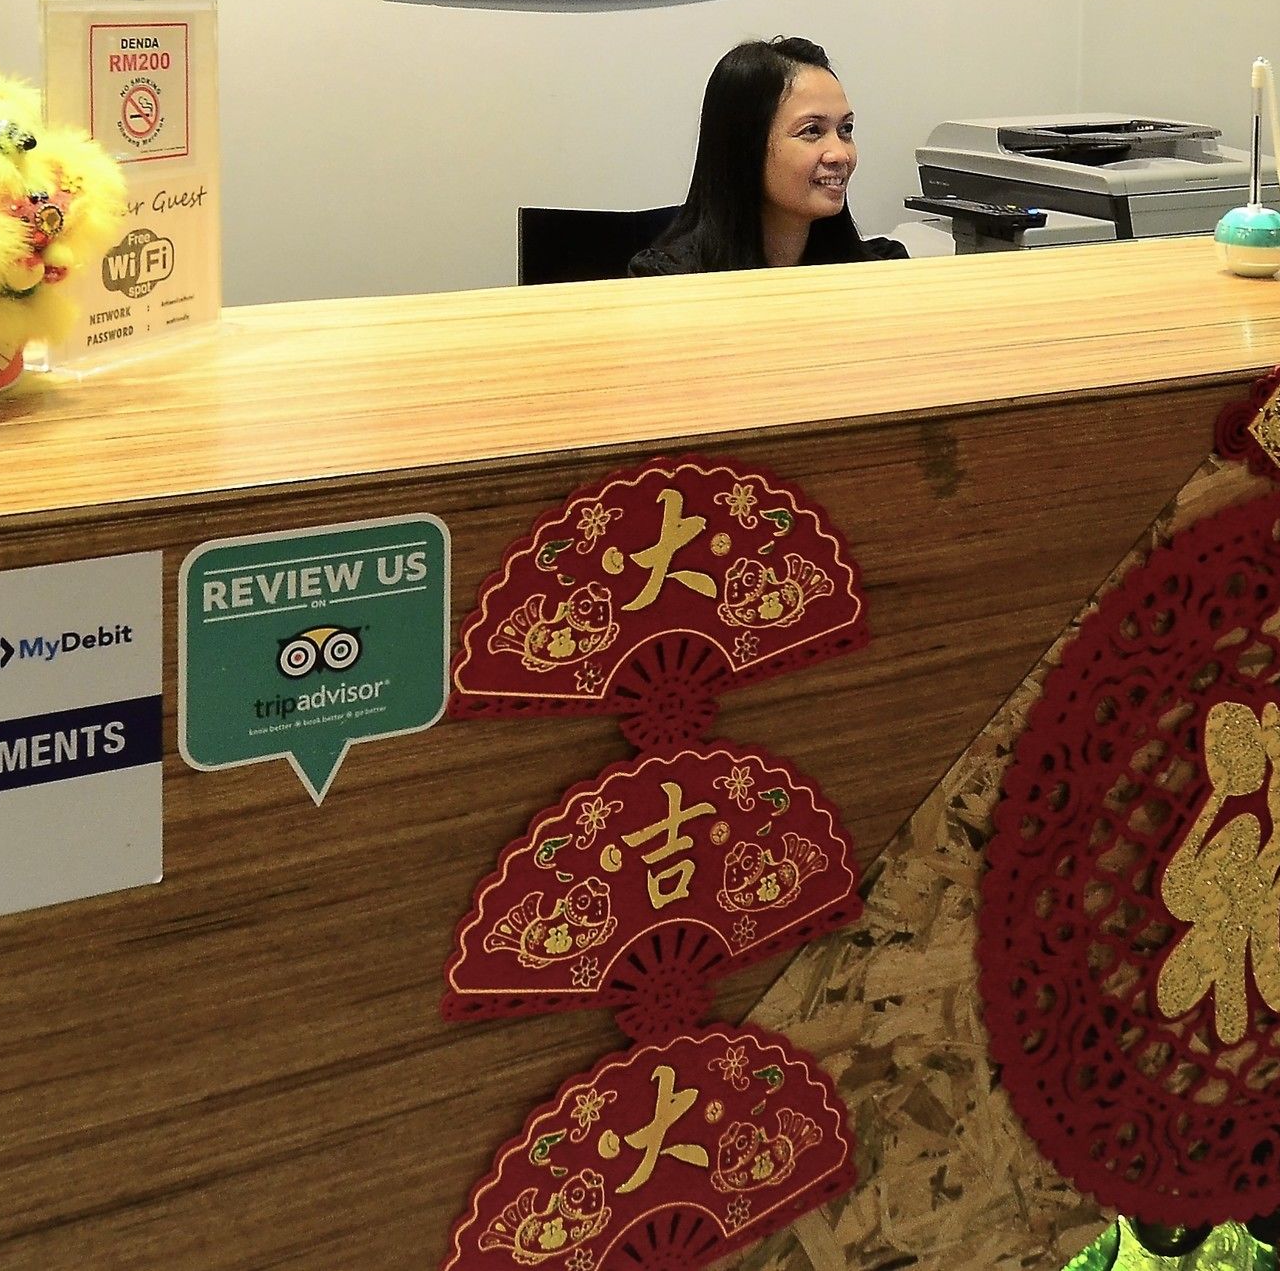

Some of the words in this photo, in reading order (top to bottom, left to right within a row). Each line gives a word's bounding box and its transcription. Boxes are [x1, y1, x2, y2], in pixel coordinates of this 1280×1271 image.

[120, 37, 160, 50] DENDA
[109, 52, 171, 72] RM200
[120, 84, 130, 98] NO
[130, 77, 162, 95] SMOKING
[152, 185, 207, 213] Guest
[128, 233, 151, 246] Free
[128, 283, 151, 298] spot
[89, 306, 131, 326] NETWORK
[86, 325, 134, 346] PASSWORD
[621, 489, 717, 613] 大
[202, 560, 363, 612] REVIEW
[377, 551, 428, 585] US
[311, 599, 326, 608] ON
[19, 625, 132, 661] MyDebit
[254, 680, 384, 719] tripadvisor
[619, 781, 717, 910] 吉
[615, 1065, 711, 1195] 大
